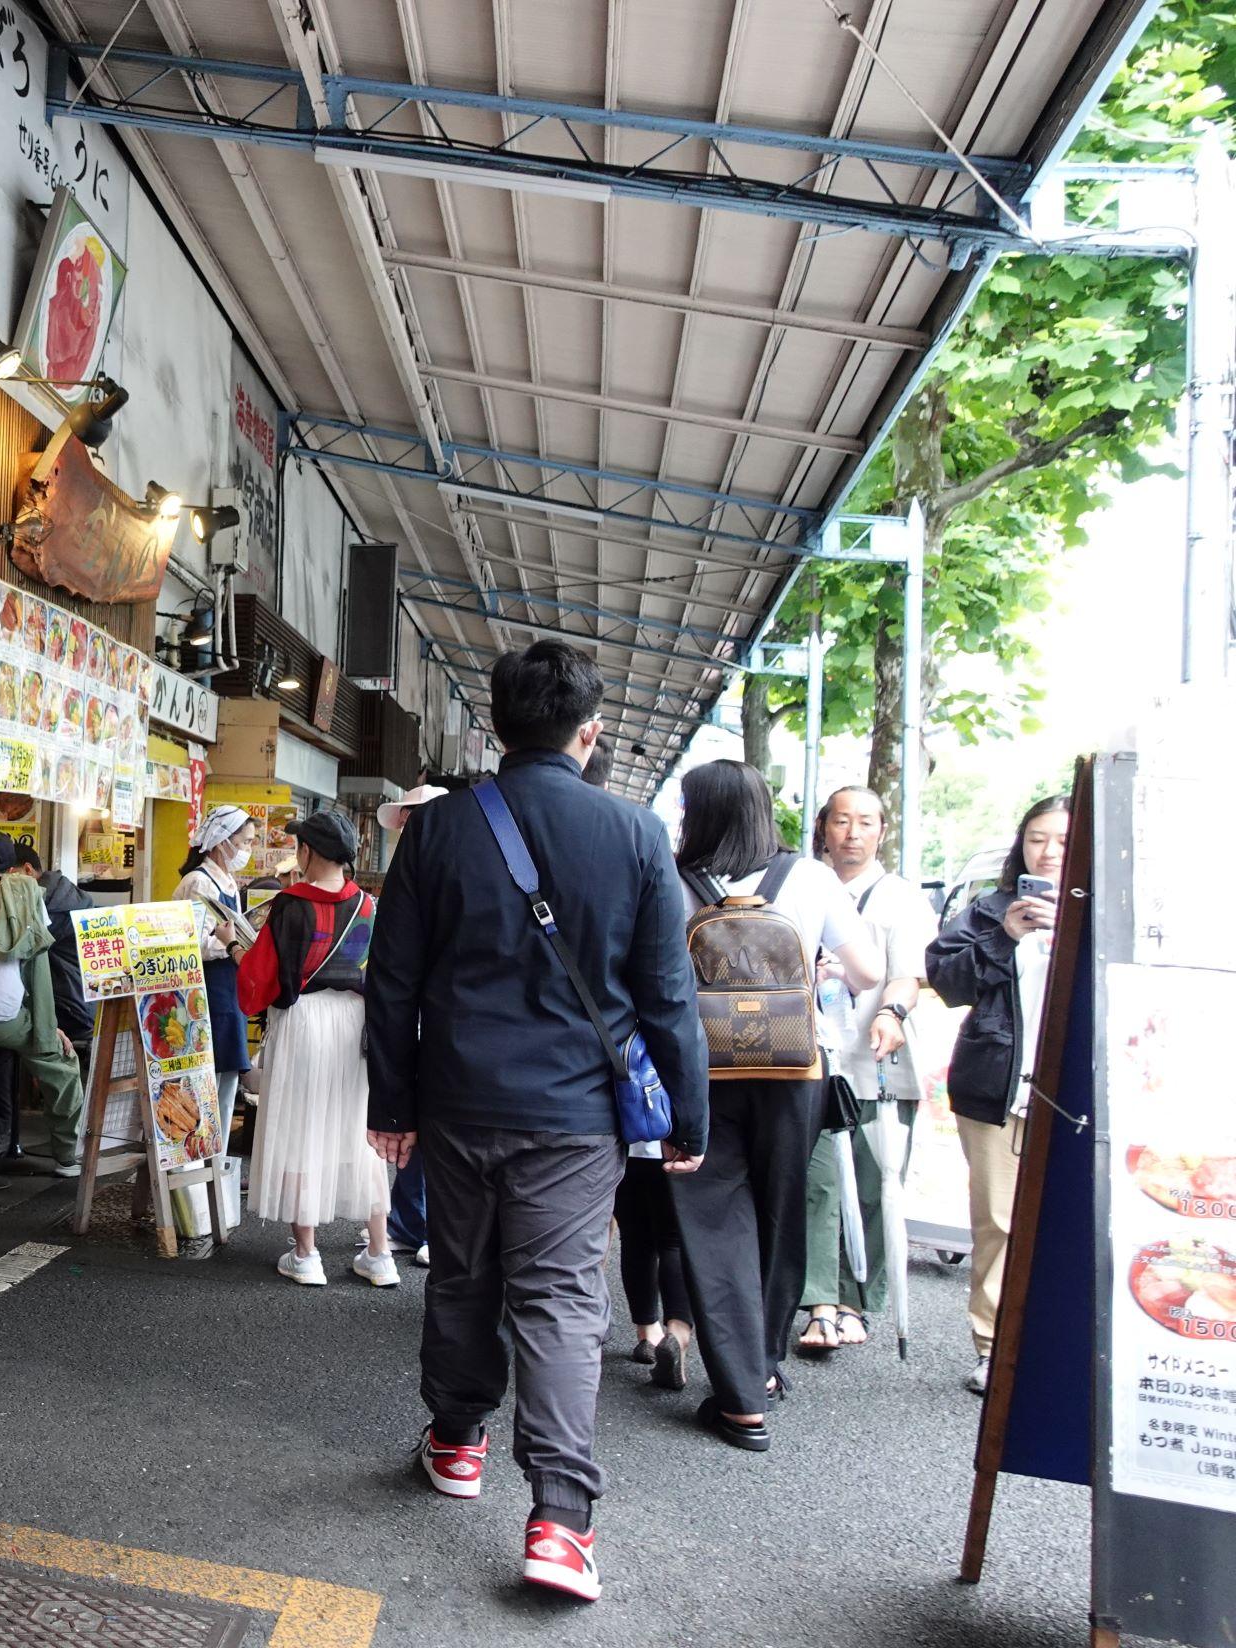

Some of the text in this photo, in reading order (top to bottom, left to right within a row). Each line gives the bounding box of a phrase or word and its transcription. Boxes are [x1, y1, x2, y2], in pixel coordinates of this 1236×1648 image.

[81, 937, 125, 959] 営業中
[90, 956, 123, 971] OPEN
[133, 953, 203, 985] つきじかんの 本店
